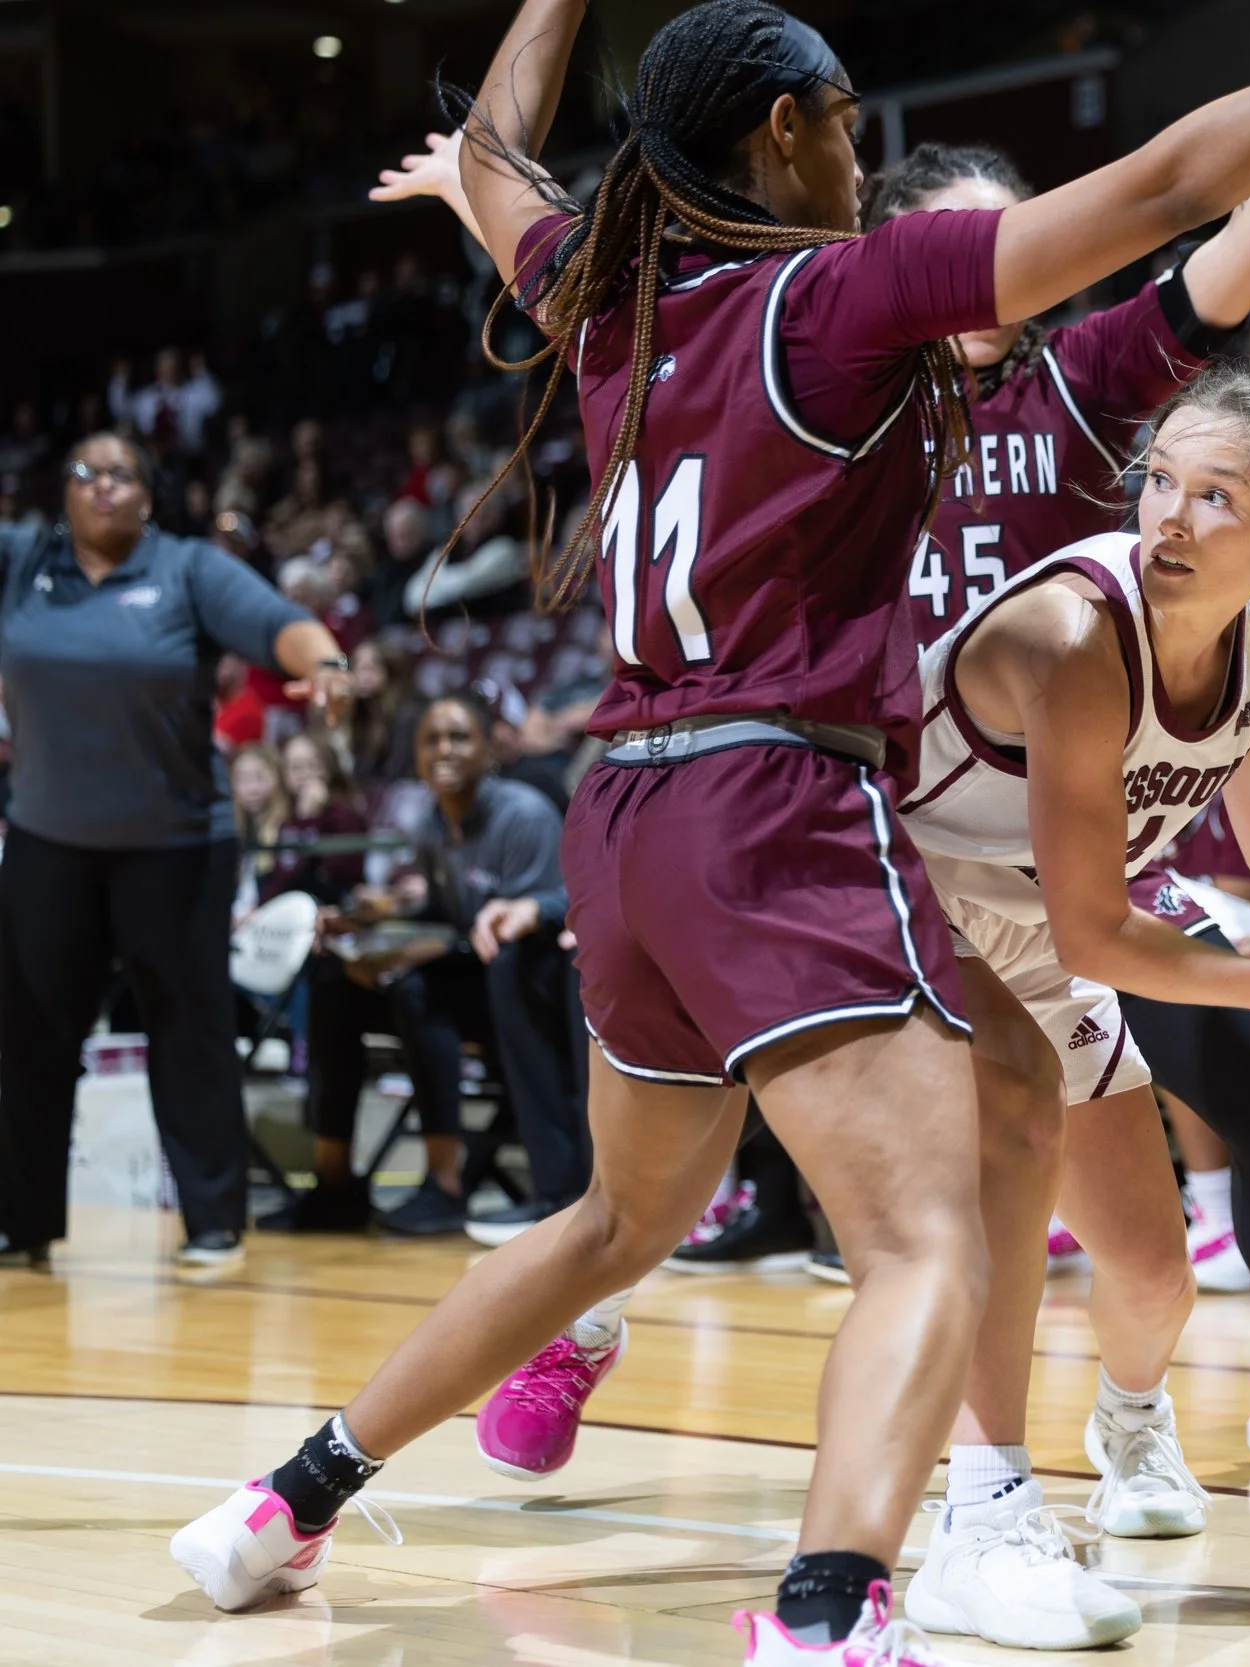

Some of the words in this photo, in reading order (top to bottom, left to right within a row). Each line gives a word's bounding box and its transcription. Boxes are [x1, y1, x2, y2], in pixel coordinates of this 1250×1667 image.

[601, 459, 712, 666] 11
[908, 524, 1007, 617] 45
[1068, 1030, 1110, 1050] adidas
